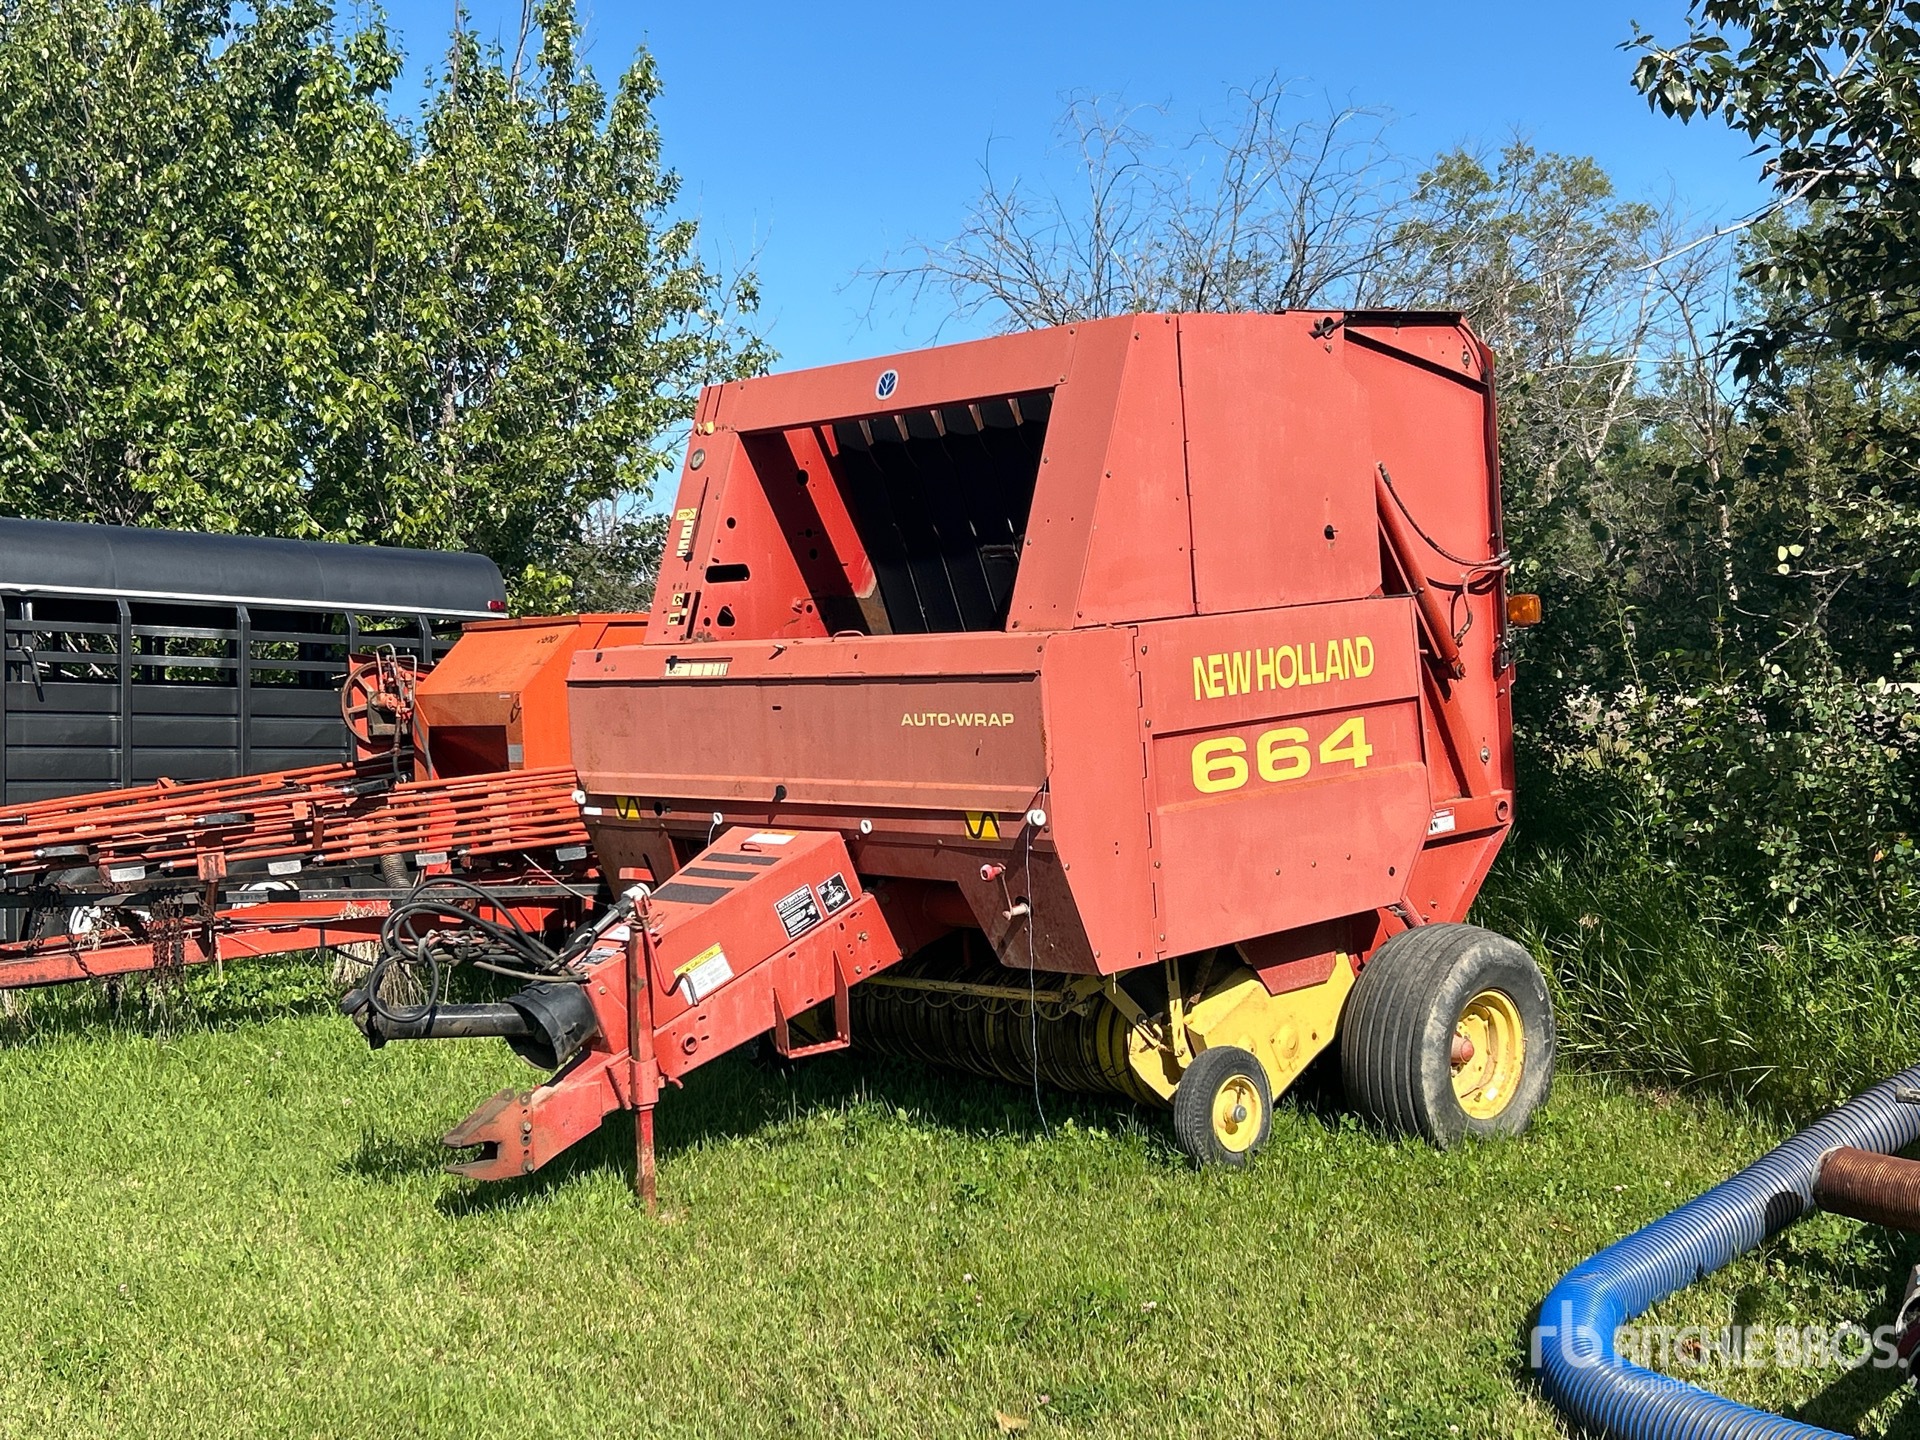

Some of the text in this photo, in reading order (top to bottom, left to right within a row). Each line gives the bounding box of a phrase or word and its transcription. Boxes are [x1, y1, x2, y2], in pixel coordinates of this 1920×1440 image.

[1192, 636, 1375, 701] NEW HOLLAND
[901, 712, 1015, 727] AUTO-WRAP
[1191, 716, 1374, 794] 664
